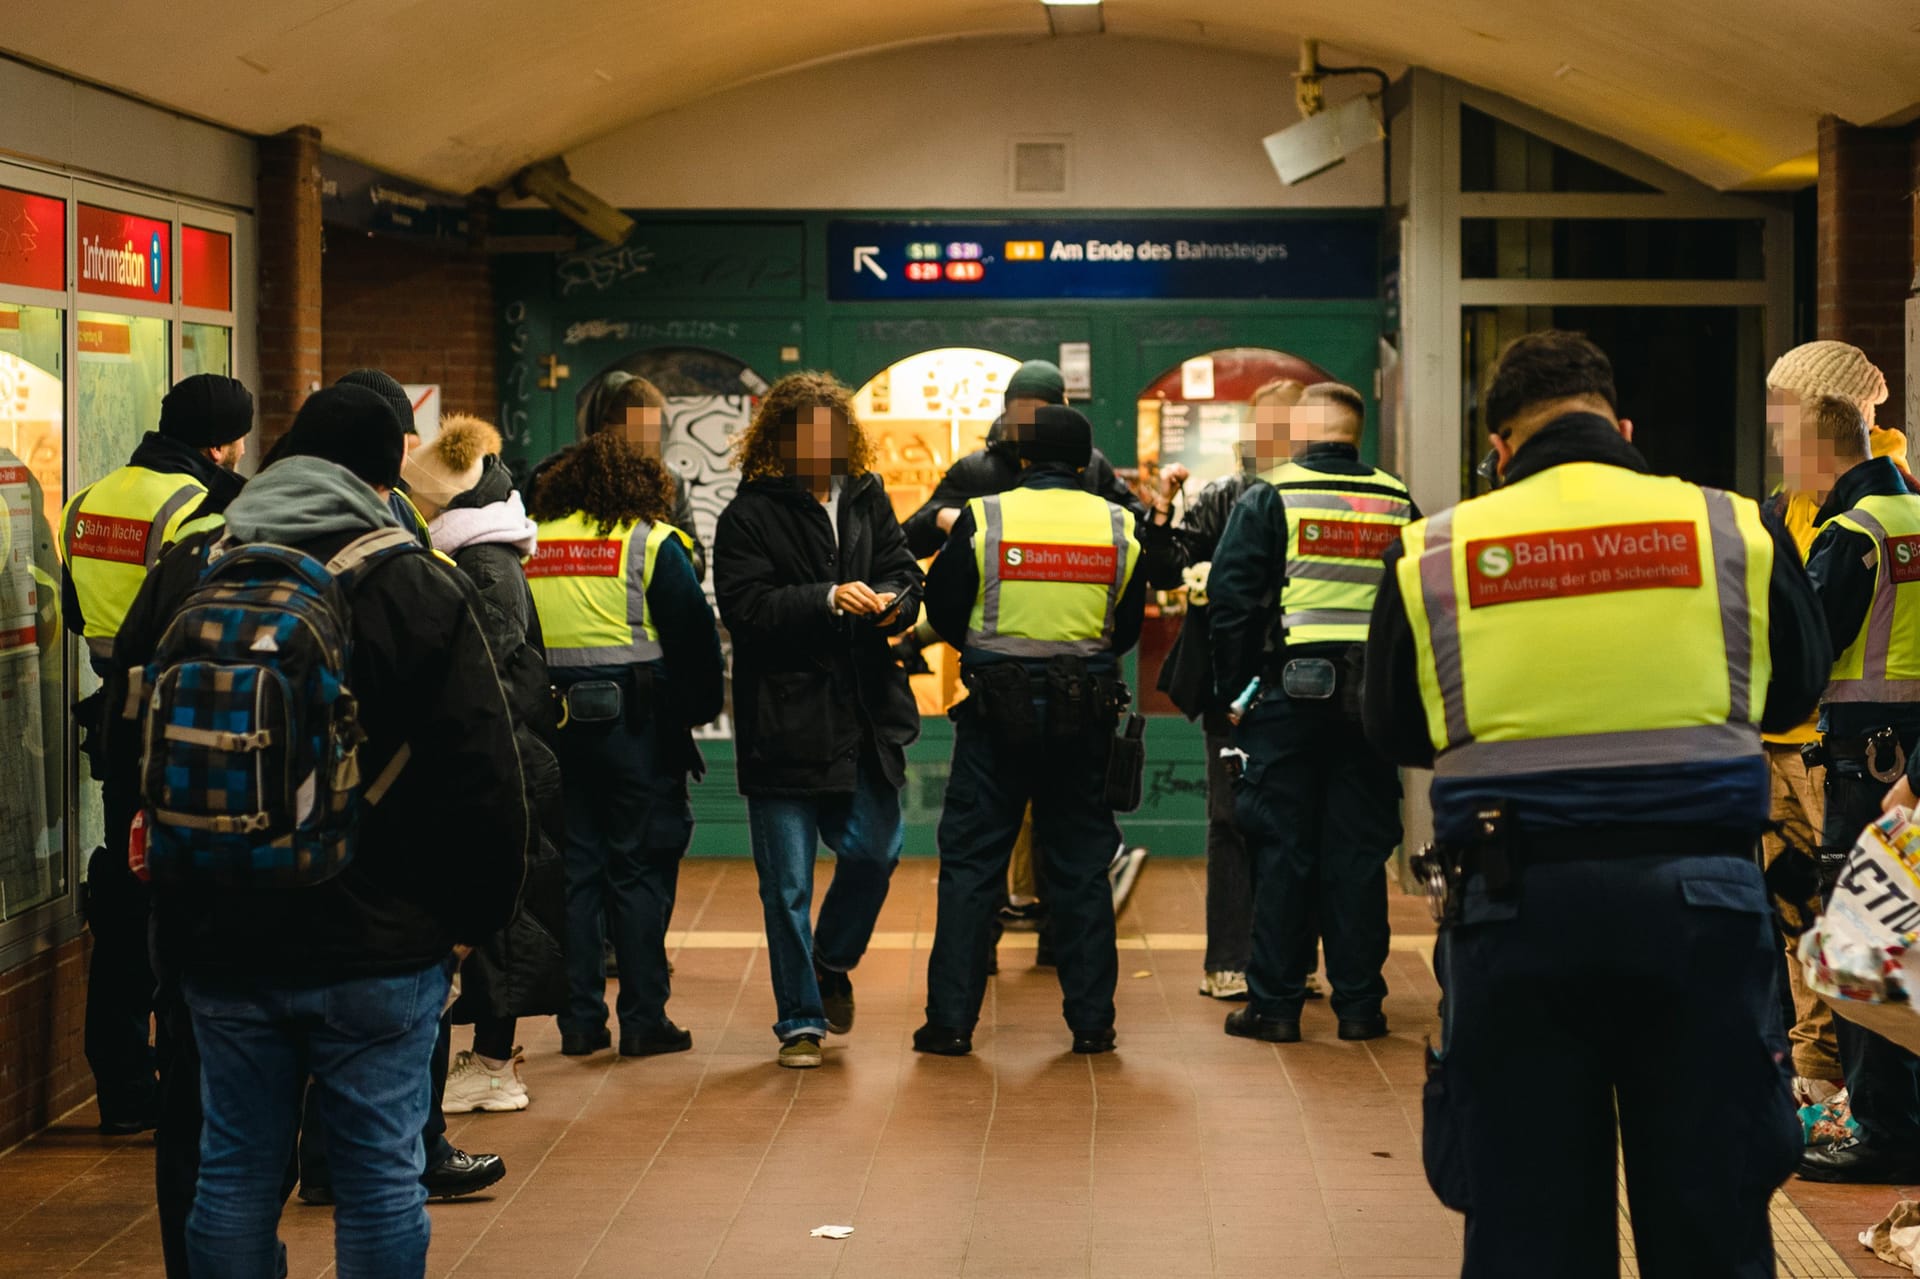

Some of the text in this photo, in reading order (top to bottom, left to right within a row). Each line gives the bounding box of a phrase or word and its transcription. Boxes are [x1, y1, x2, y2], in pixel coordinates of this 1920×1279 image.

[82, 234, 145, 288] Information
[1050, 240, 1083, 261] Am
[1086, 240, 1134, 261] Ende
[1136, 240, 1171, 261] des
[1175, 240, 1288, 263] Bahnsteiges
[85, 520, 110, 538] Bahn
[112, 523, 143, 542] Wache
[1323, 526, 1354, 540] Bahn
[568, 544, 617, 560] Wache
[1025, 549, 1062, 565] Bahn
[1065, 552, 1113, 567] Wache
[1516, 538, 1584, 566] Bahn
[1592, 529, 1688, 557] Wache
[1480, 564, 1689, 595] Im Auftrag der DB Sicherheit
